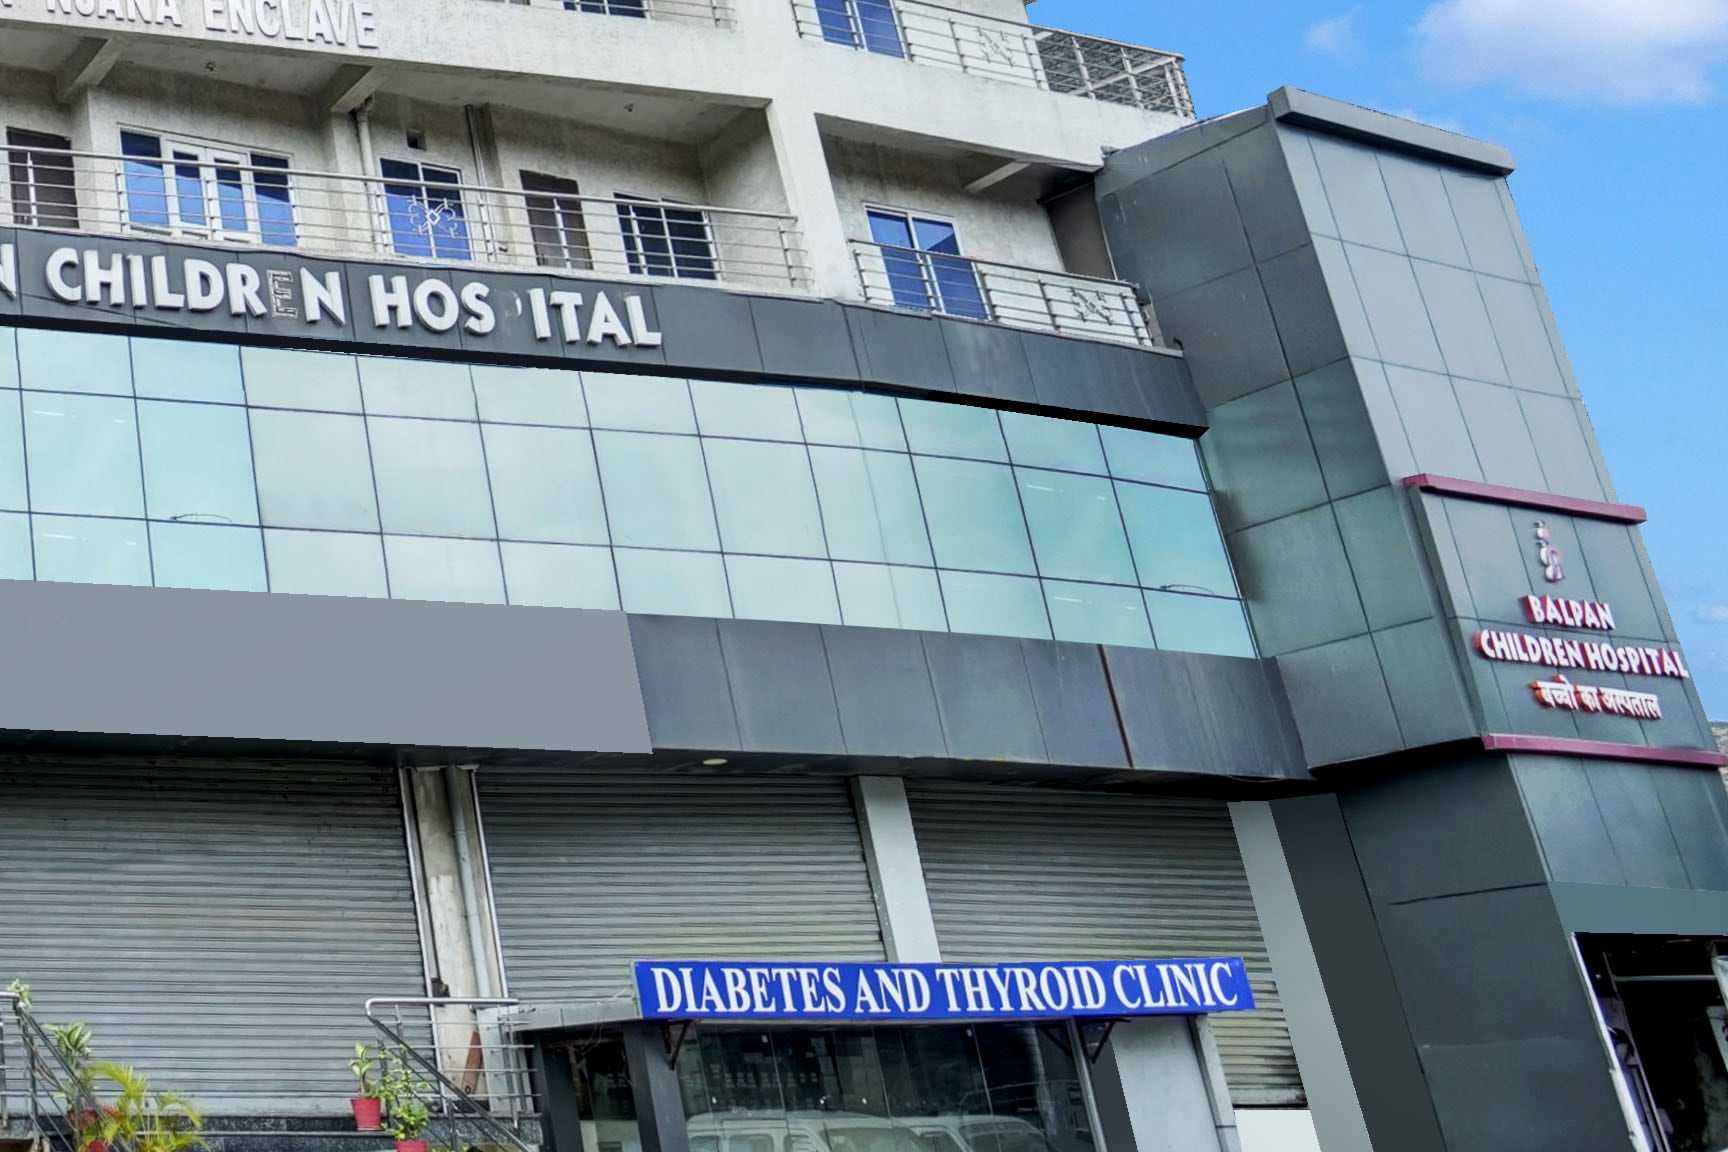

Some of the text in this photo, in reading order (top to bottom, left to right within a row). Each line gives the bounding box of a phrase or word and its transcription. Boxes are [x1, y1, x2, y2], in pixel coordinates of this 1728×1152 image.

[45, 246, 347, 327] CHILDREN
[368, 273, 663, 348] HOSITAL
[1526, 595, 1616, 631] BALPAN
[1477, 629, 1690, 680] CHILDREN HOSPITAL
[650, 961, 1240, 1015] DIABETES AND THYROID CLINIC
